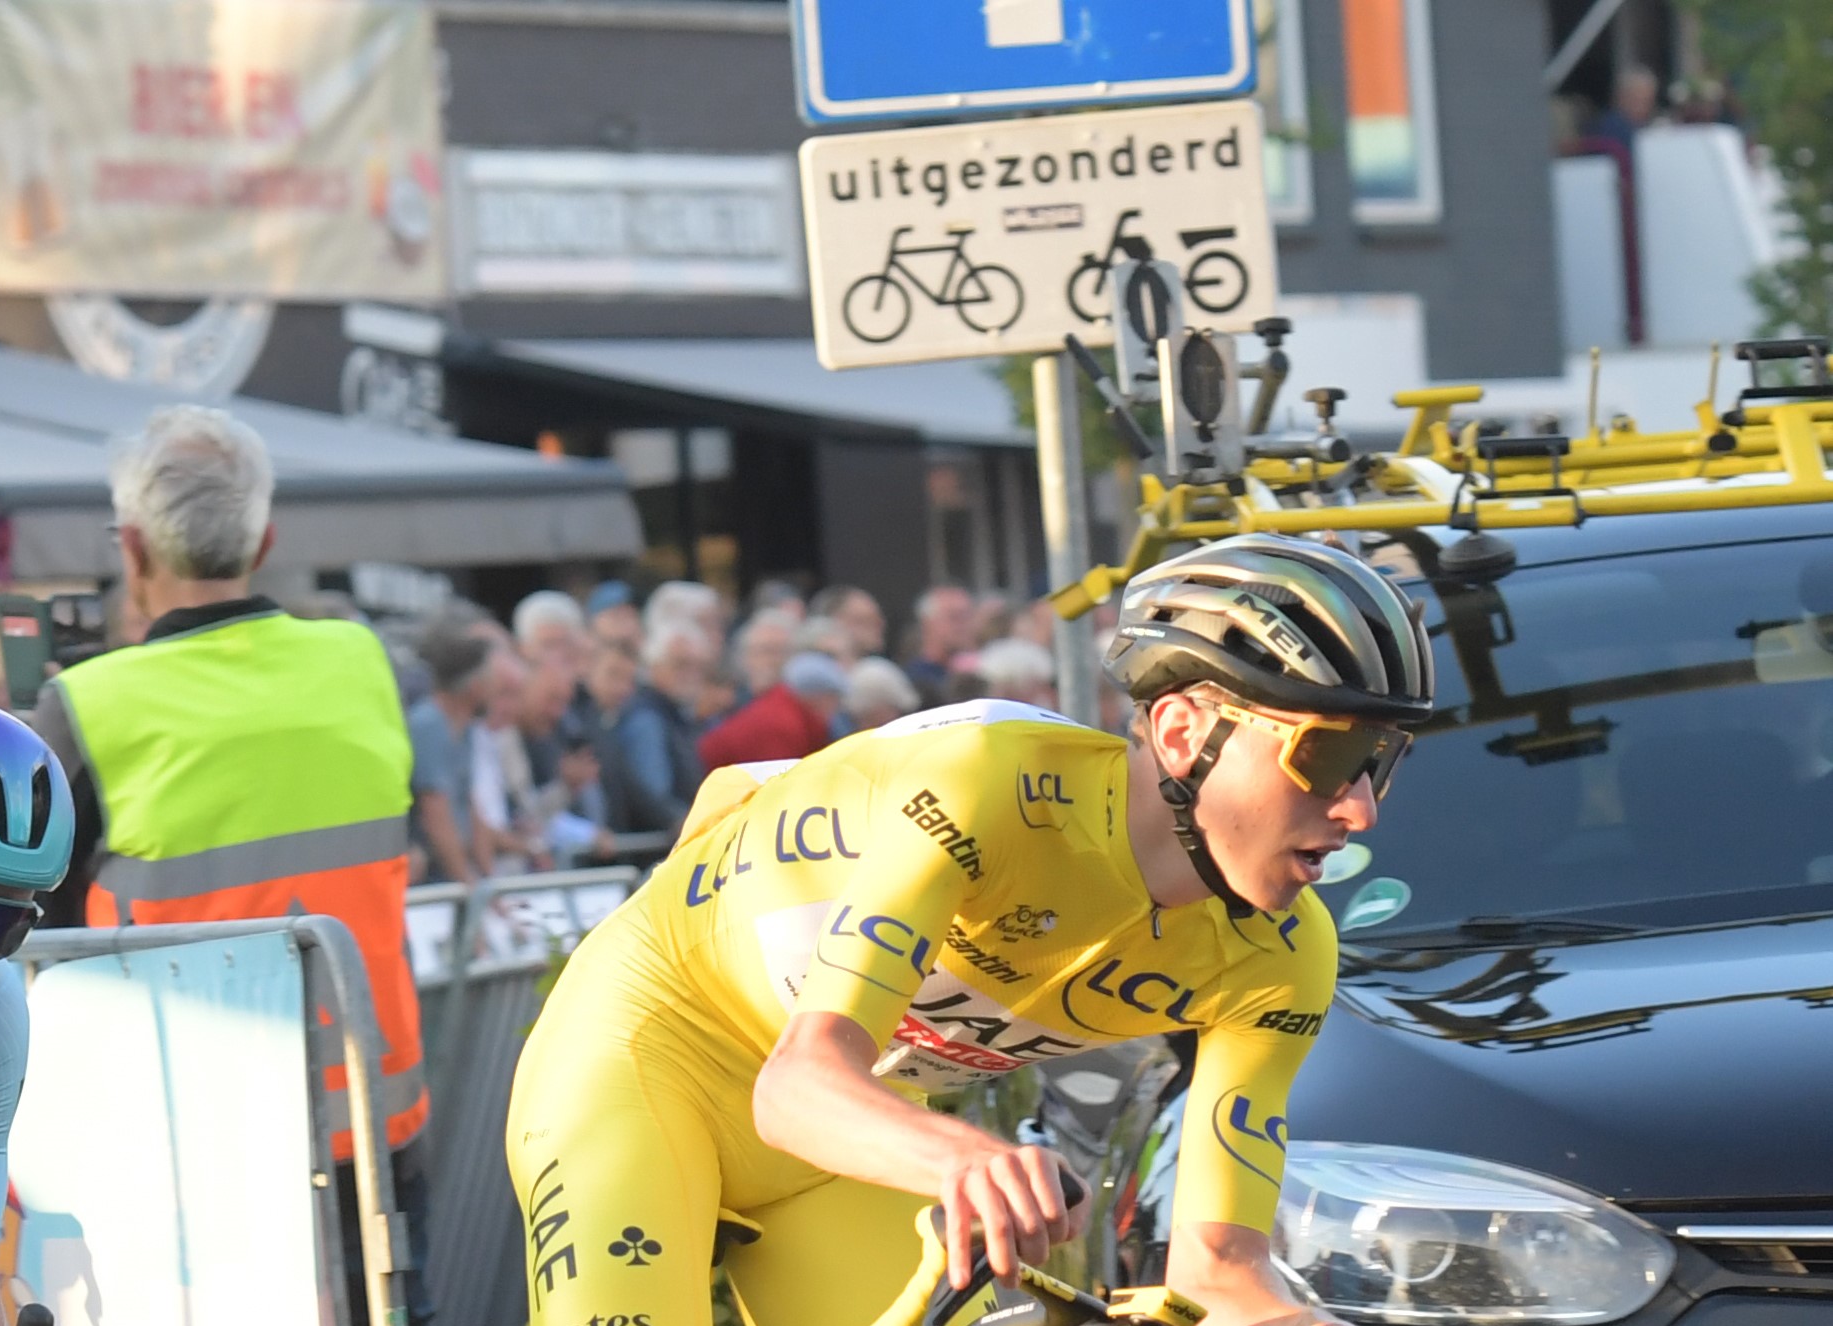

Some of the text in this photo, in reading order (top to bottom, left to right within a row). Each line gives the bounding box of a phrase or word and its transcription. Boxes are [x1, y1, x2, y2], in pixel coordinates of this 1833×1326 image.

[829, 126, 1241, 207] uitgezonderd
[1022, 772, 1074, 805] LCL
[775, 806, 861, 864] LCL
[829, 905, 931, 980] LCL
[1086, 959, 1206, 1026] LCL
[529, 1158, 578, 1313] UAE
